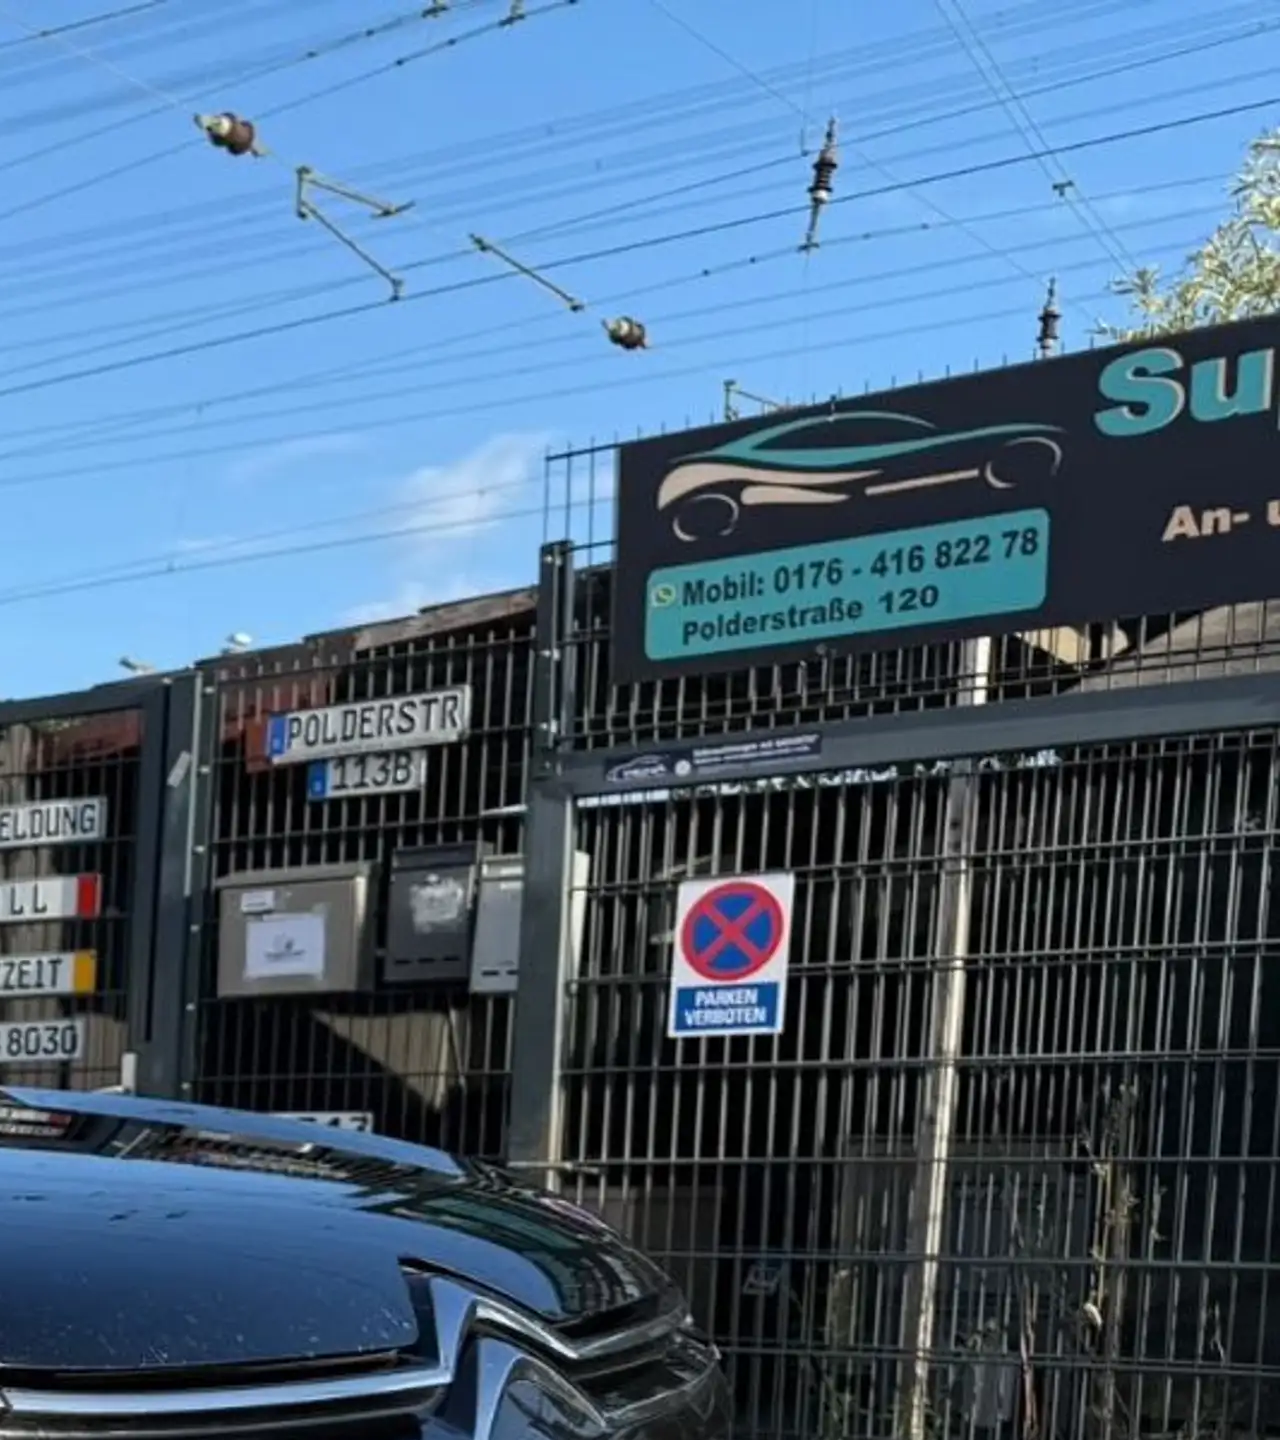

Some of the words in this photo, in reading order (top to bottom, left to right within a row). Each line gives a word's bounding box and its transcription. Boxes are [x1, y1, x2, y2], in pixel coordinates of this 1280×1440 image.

[1094, 347, 1280, 437] Su
[1161, 504, 1250, 542] An-
[682, 574, 764, 607] Mobil:
[773, 557, 842, 594] 0176
[870, 545, 925, 578] 416
[934, 534, 991, 571] 822
[1002, 527, 1039, 559] 78
[682, 598, 864, 646] Polderstraße
[882, 585, 939, 614] 120
[288, 695, 458, 748] POLDERSTR
[331, 752, 413, 791] 113B
[684, 1006, 768, 1026] VERBOTEN
[694, 988, 759, 1007] PARKEN
